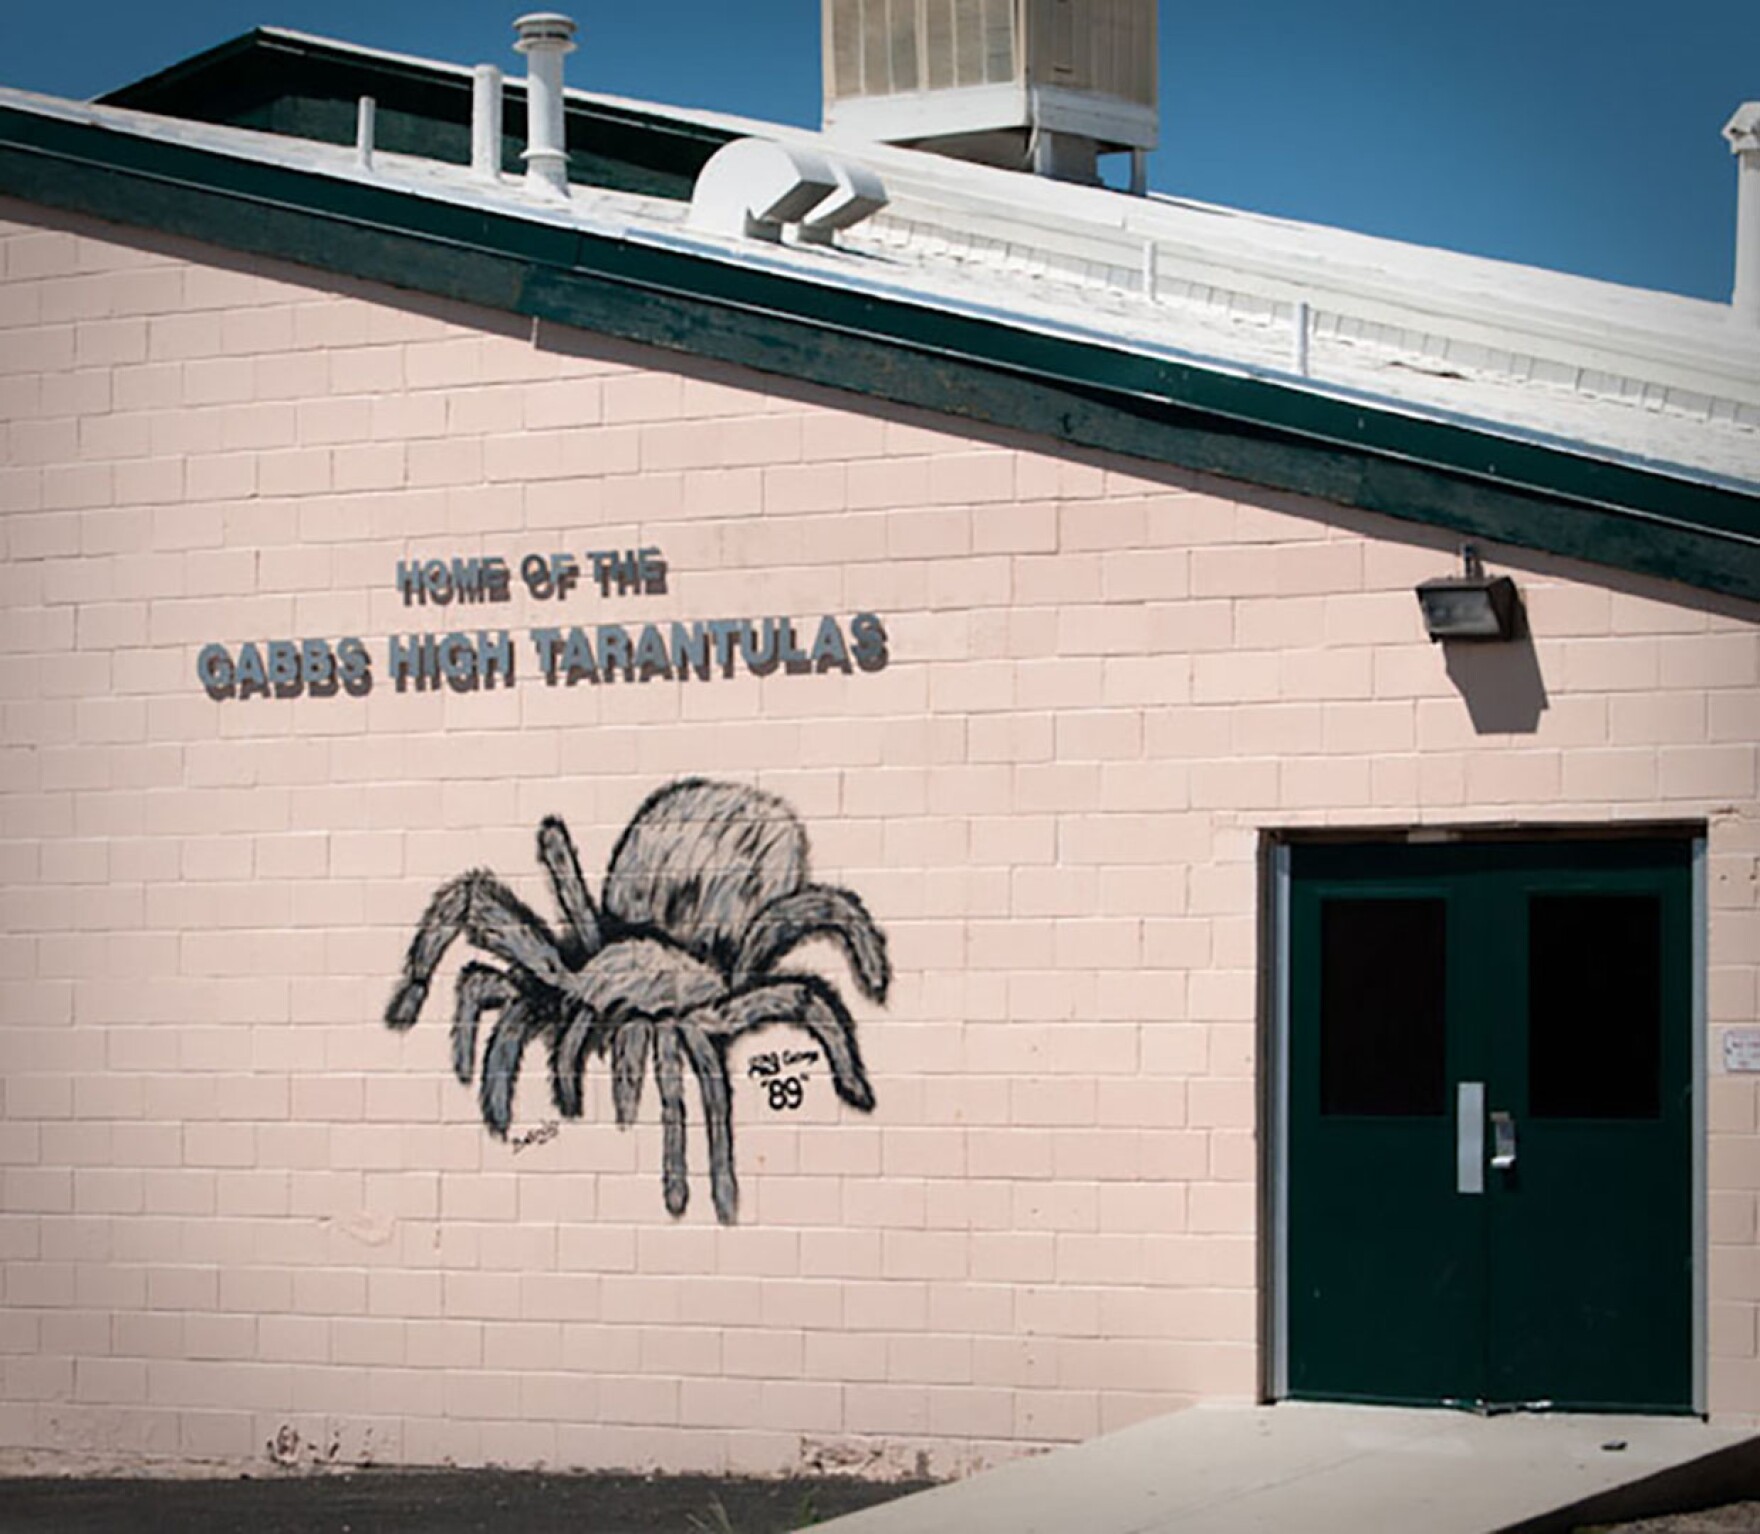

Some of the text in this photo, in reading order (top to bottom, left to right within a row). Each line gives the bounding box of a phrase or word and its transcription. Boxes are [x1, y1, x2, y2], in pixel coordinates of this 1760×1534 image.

[396, 547, 666, 602] HOME OF THE
[197, 611, 888, 698] GABBS HIGH TARANTULAS
